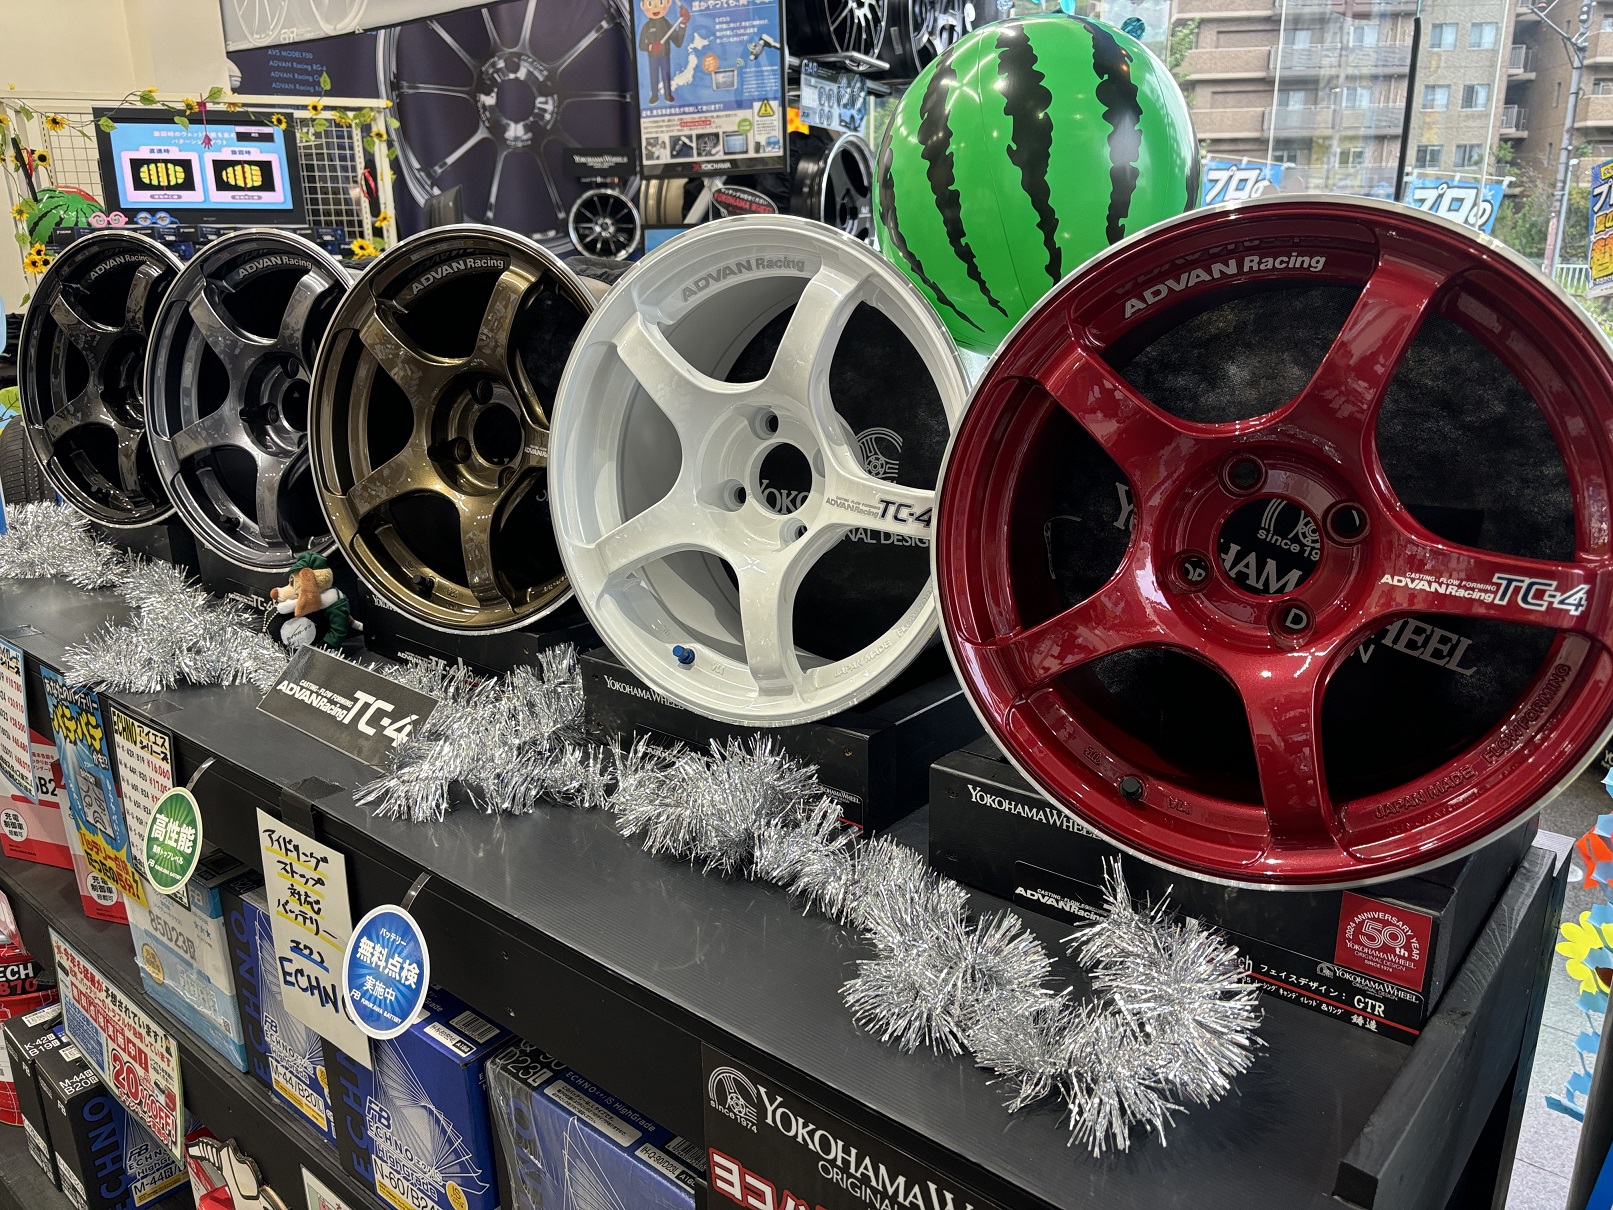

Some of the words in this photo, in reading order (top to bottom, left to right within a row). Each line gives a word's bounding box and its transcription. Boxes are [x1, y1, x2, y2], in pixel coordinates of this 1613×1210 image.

[90, 255, 125, 280] ADVAN
[238, 256, 281, 279] ADVAN
[282, 256, 312, 269] Racing
[412, 260, 465, 294] ADVAN
[466, 257, 504, 268] Racing
[682, 260, 753, 302] ADVAN
[756, 256, 805, 272] Racing
[1125, 259, 1238, 319] ADVAN
[1243, 252, 1326, 272] Racing
[879, 498, 932, 528] TC-4
[1257, 529, 1300, 554] since
[1406, 572, 1435, 582] CASTING
[1440, 577, 1461, 586] FLOW
[1461, 581, 1497, 592] FORMING
[1491, 572, 1592, 616] TC-4
[299, 679, 319, 691] CASTING
[319, 687, 331, 698] FLOW
[331, 692, 354, 707] FORMING
[112, 710, 138, 747] ECHNO
[342, 690, 420, 748] TC-4
[137, 725, 168, 751] アイエス
[147, 757, 170, 781] ¥16,060
[1374, 789, 1428, 821] JAPAN
[1428, 763, 1477, 802] MADE
[4, 812, 19, 823] 充電
[4, 820, 24, 831] 制御車
[151, 813, 196, 854] 高性能
[263, 829, 329, 872] アイドリング
[92, 875, 109, 886] 充電
[276, 859, 326, 888] ストップ
[91, 883, 113, 894] 制御車
[287, 883, 322, 916] 対応
[1037, 888, 1061, 900] CASTING
[1064, 896, 1080, 908] FLOW
[276, 898, 338, 940] バッテリー
[379, 927, 406, 947] バッテリー
[1345, 921, 1356, 939] 2024
[1354, 911, 1414, 936] ANNIVERSARY
[1410, 937, 1420, 960] YEAR
[356, 936, 420, 989] 無料点検
[1354, 951, 1382, 965] ORIGINAL
[1383, 960, 1406, 972] DESIGN
[230, 909, 270, 1085] ECHNO
[363, 975, 396, 1003] 実施中
[360, 998, 383, 1015] FURUKAWA
[383, 1009, 402, 1024] BATTERY
[1354, 995, 1385, 1017] GTR
[264, 1012, 278, 1034] FB
[1351, 1013, 1378, 1032] 鋳造
[264, 1030, 296, 1058] ECHNO
[270, 1048, 309, 1083] HighGrade
[57, 1099, 67, 1117] FB
[366, 1096, 392, 1131] FB
[565, 1071, 596, 1094] ECHNO
[613, 1101, 656, 1133] HighGrade
[710, 1100, 735, 1119] since
[736, 1114, 758, 1133] 1974
[128, 1143, 149, 1162] FB
[367, 1117, 414, 1163] ECHNO
[376, 1142, 438, 1200] HighGrade
